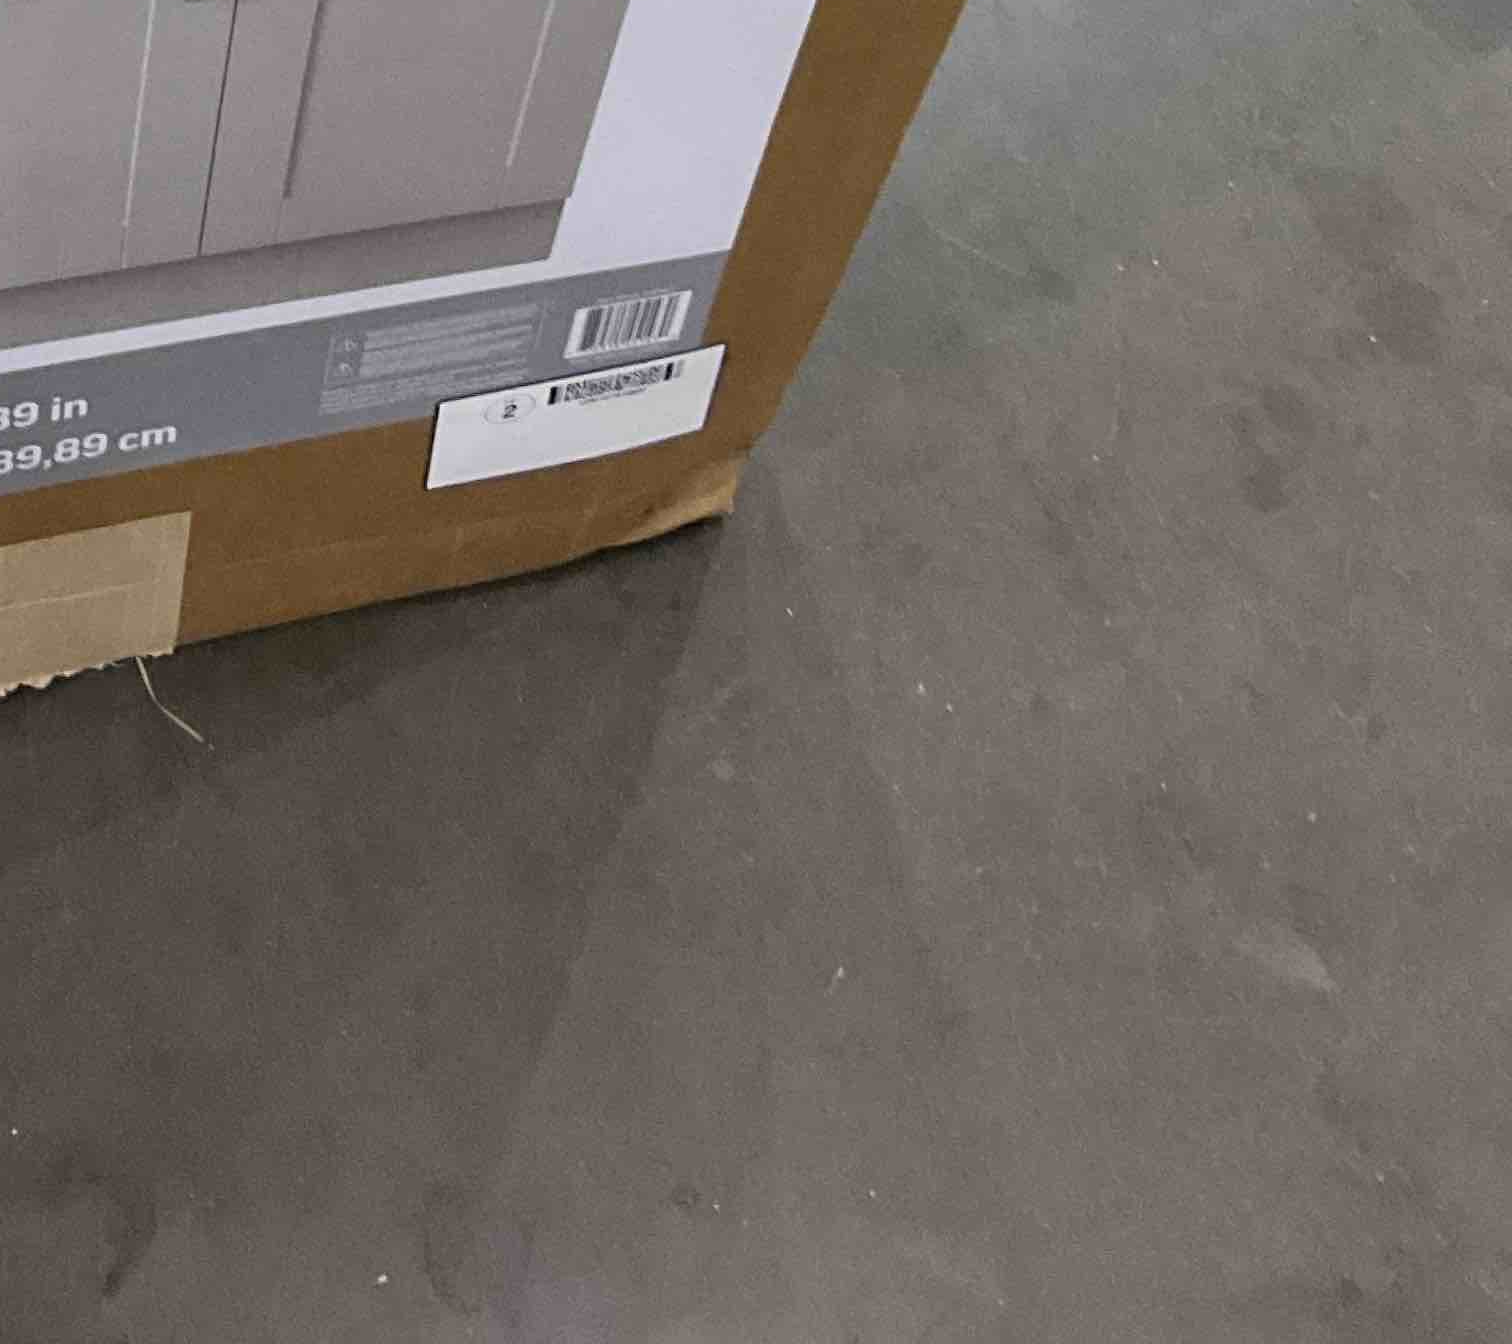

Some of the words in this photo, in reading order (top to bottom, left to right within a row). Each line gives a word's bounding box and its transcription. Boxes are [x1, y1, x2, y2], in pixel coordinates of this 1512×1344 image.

[50, 396, 89, 423] in
[503, 404, 518, 420] 2
[117, 423, 178, 452] cm
